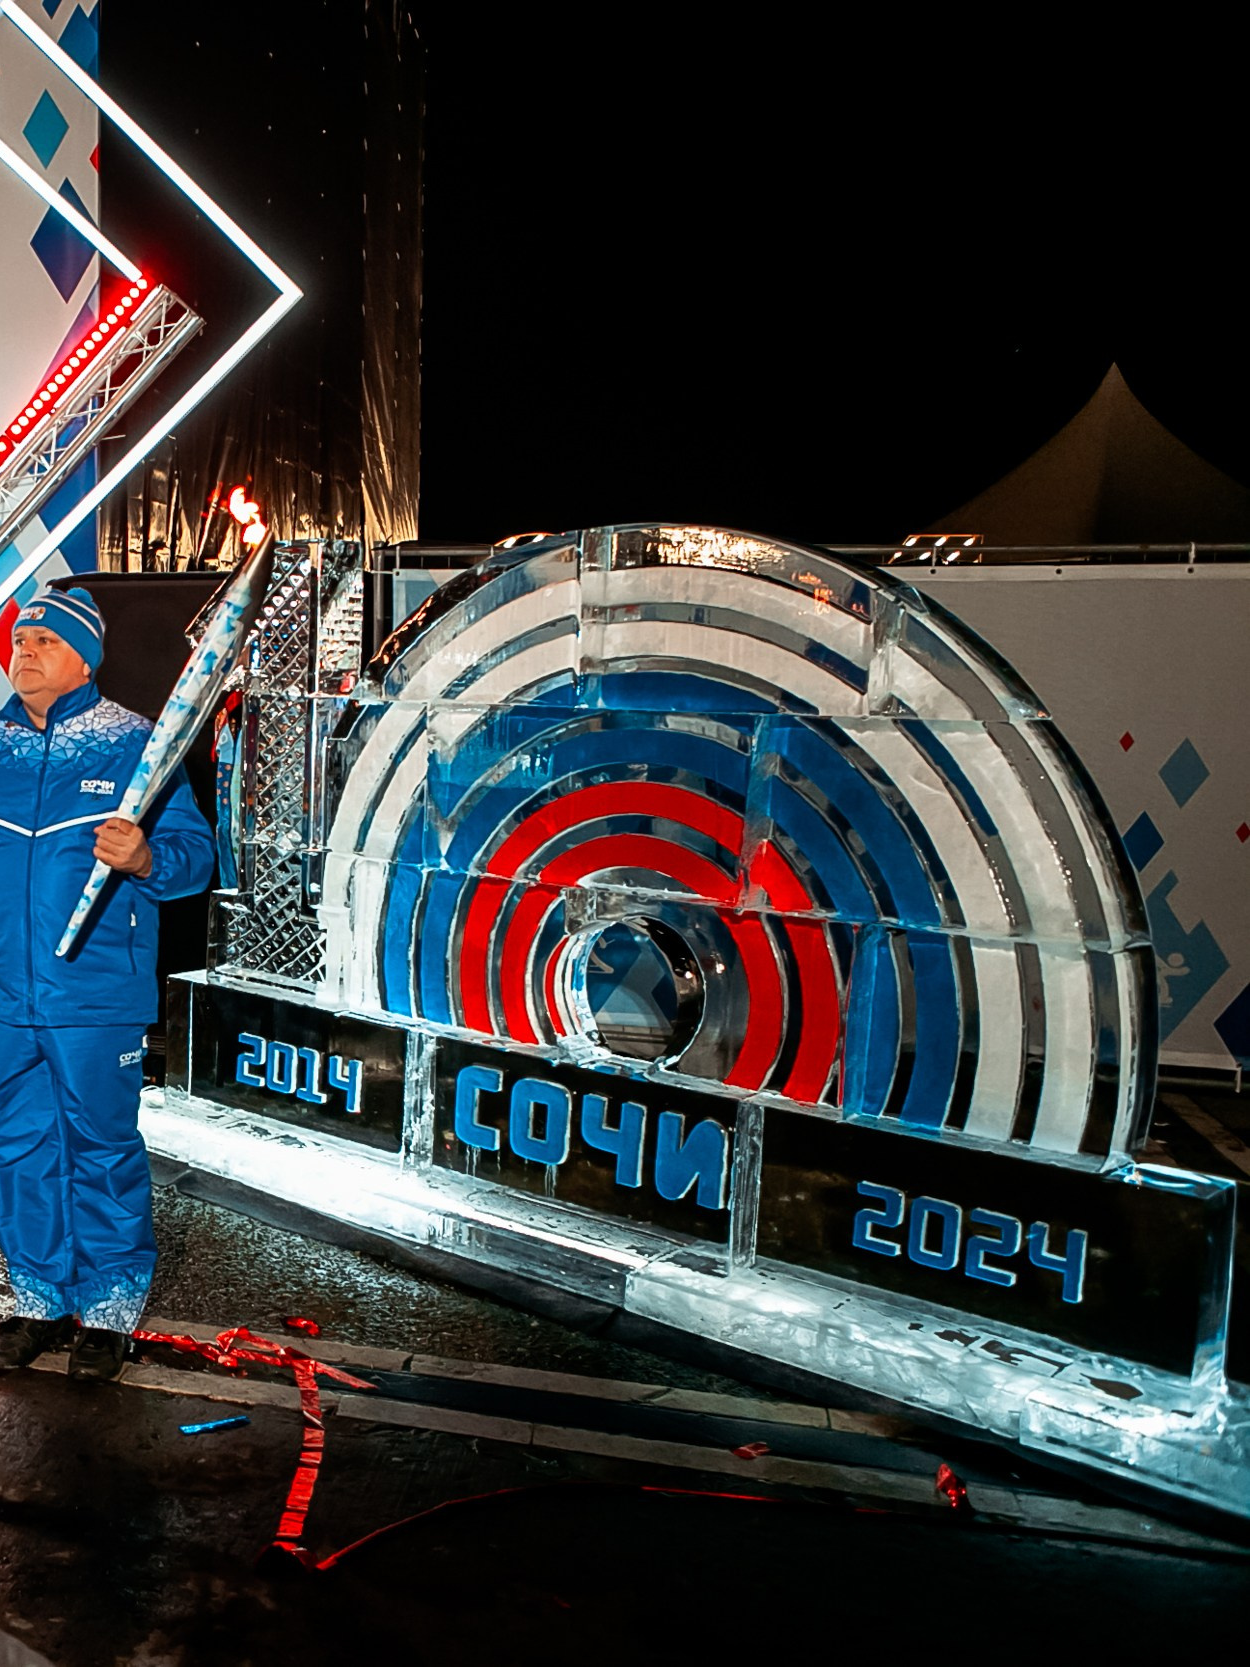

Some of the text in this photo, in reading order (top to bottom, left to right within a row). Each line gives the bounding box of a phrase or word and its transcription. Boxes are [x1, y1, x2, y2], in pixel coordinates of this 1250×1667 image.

[80, 779, 116, 791] СОЧИ
[236, 1032, 363, 1113] 2014
[455, 1062, 730, 1211] СОЧИ
[852, 1180, 1088, 1304] 2024
